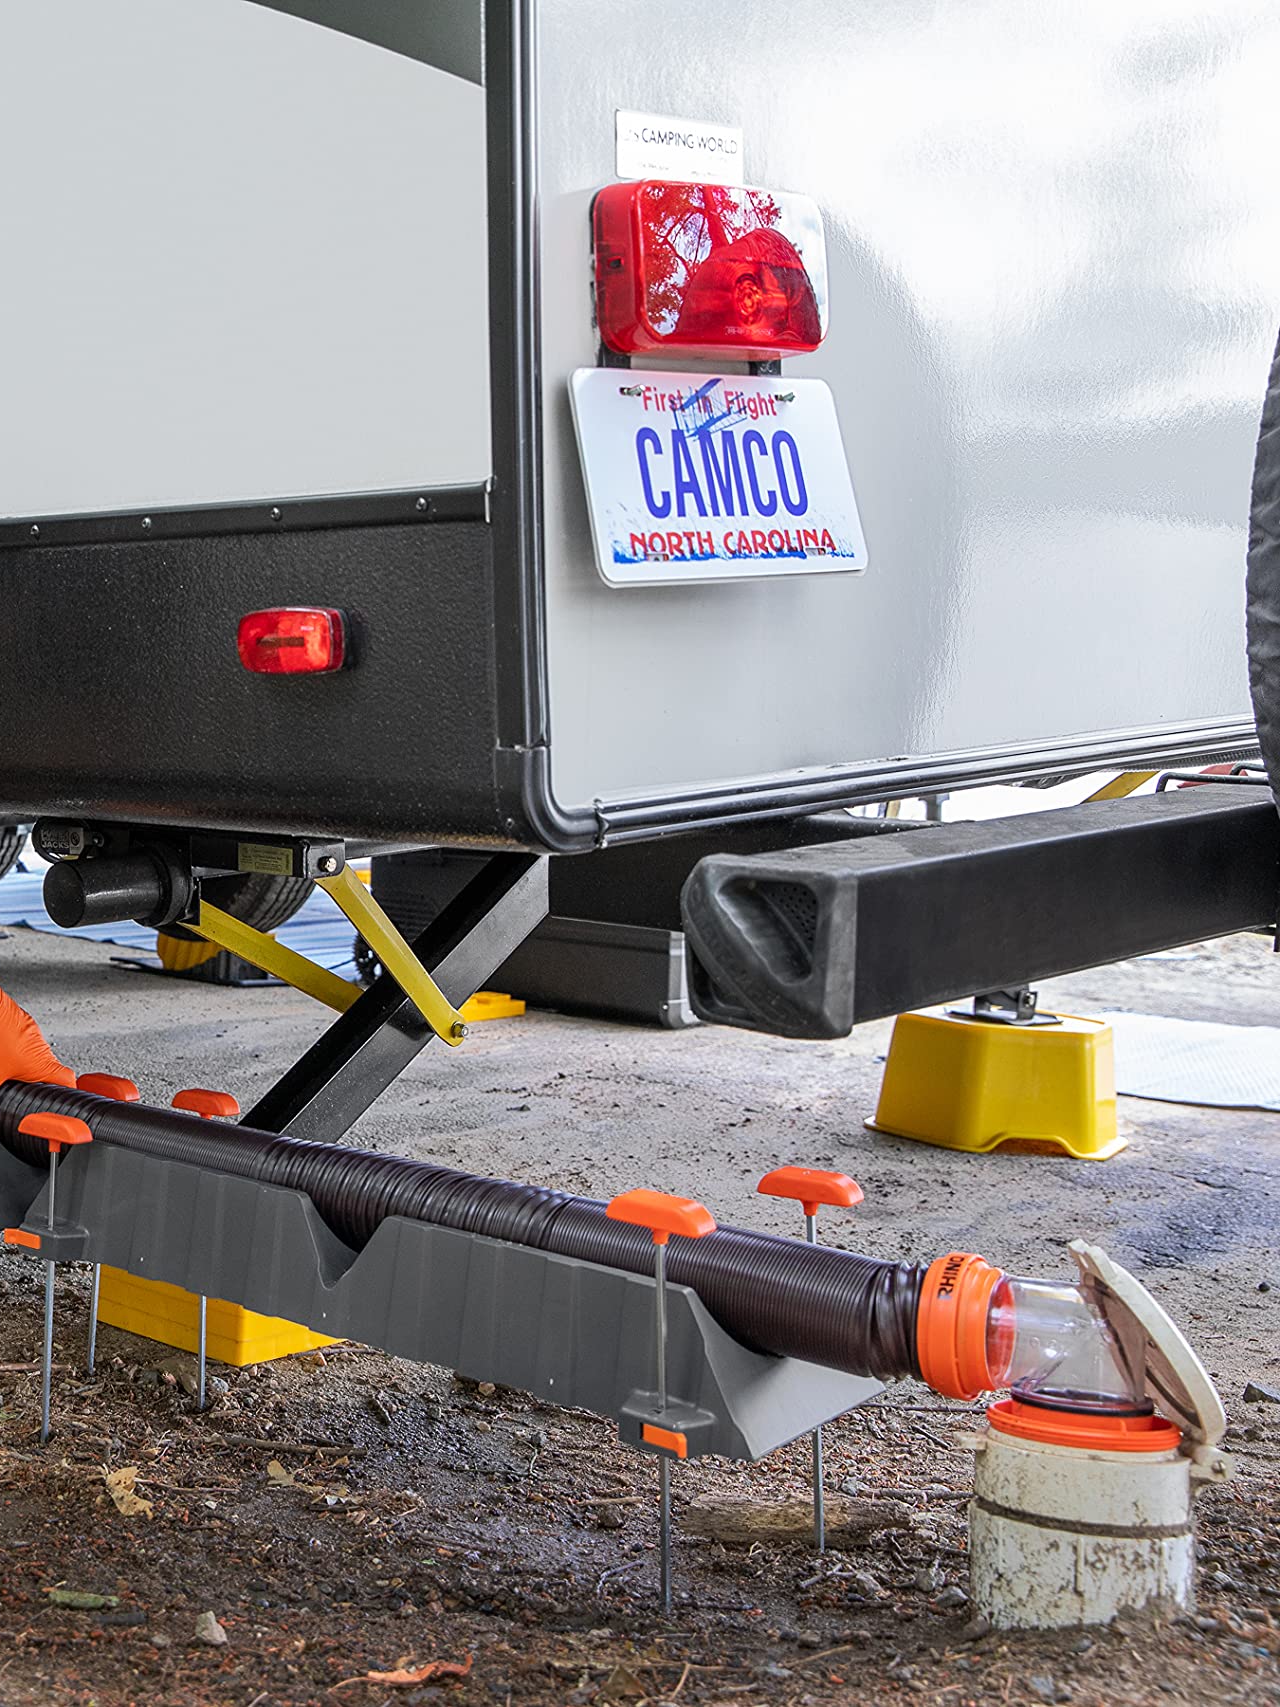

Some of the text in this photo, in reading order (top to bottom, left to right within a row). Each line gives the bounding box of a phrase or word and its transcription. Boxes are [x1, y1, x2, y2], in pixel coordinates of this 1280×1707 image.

[641, 127, 694, 149] CAMPING
[697, 135, 738, 154] WORLD
[642, 387, 685, 412] First
[725, 390, 776, 420] Flight
[635, 426, 809, 519] CAMCO
[630, 528, 837, 557] NORTH CAROLINA
[41, 841, 70, 849] JACKS
[937, 1255, 965, 1300] RHINO
